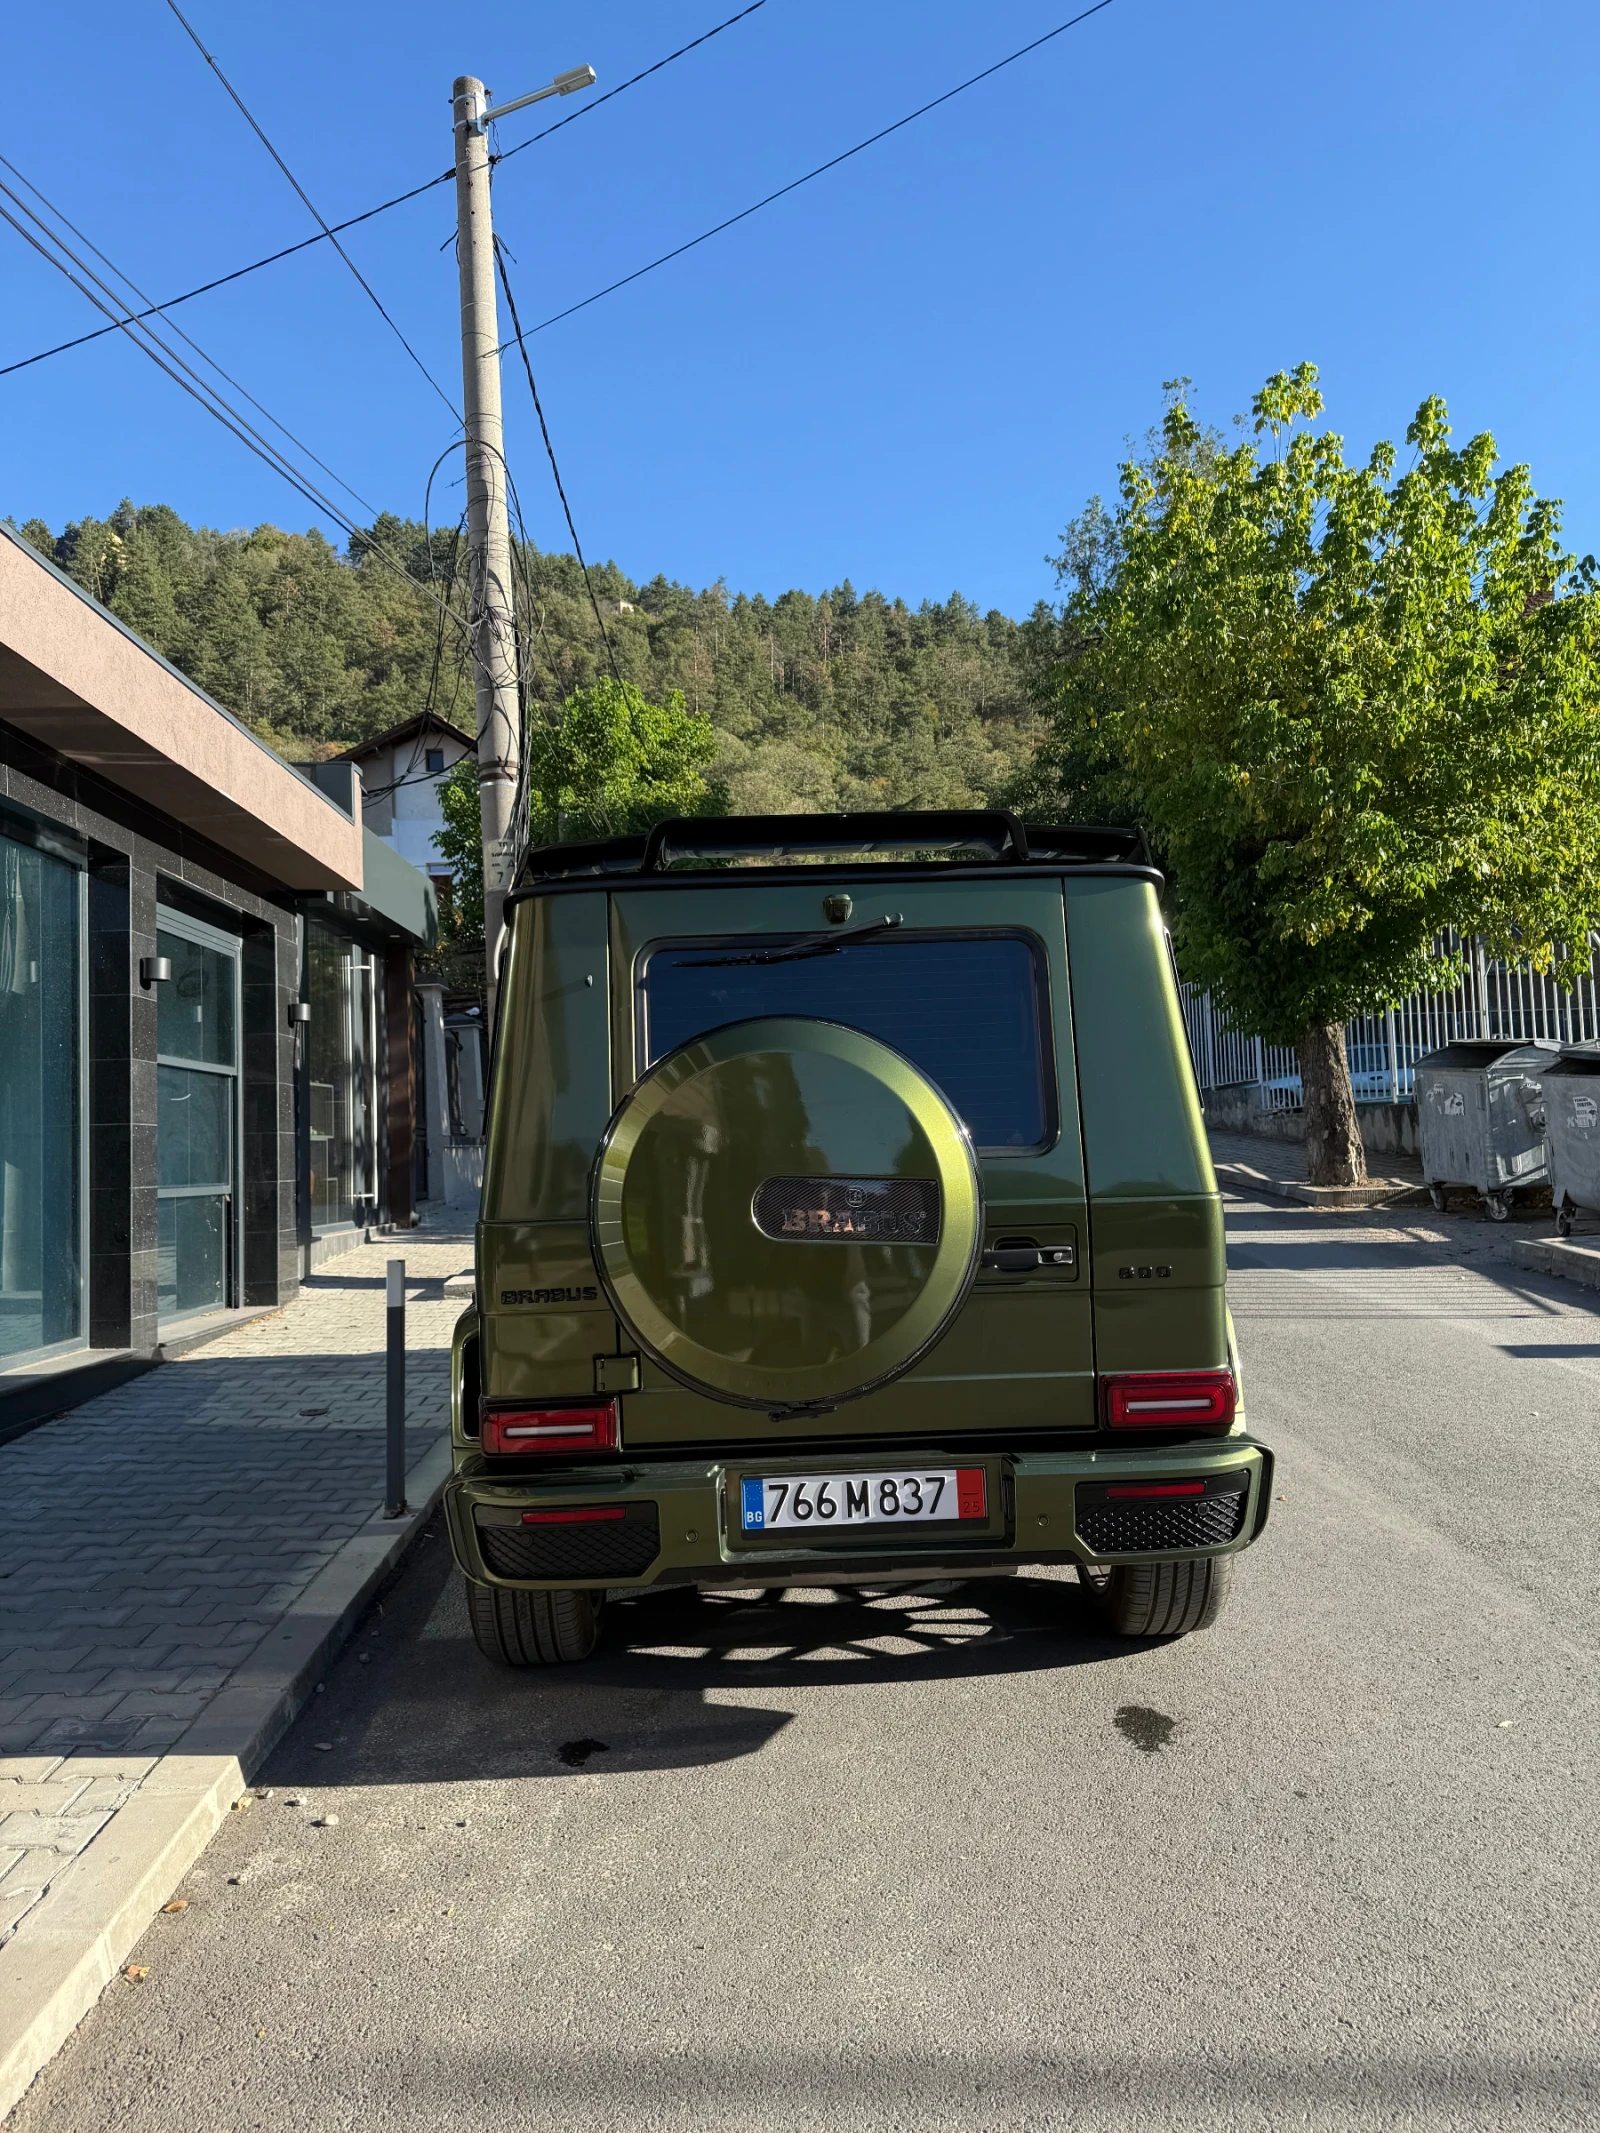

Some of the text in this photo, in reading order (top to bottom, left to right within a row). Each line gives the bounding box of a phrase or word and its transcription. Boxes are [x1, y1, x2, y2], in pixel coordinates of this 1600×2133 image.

[497, 872, 504, 884] 7
[501, 1286, 598, 1305] BRABUS
[768, 1477, 946, 1522] 766 M 837
[963, 1501, 980, 1514] 25
[746, 1512, 763, 1523] BG
